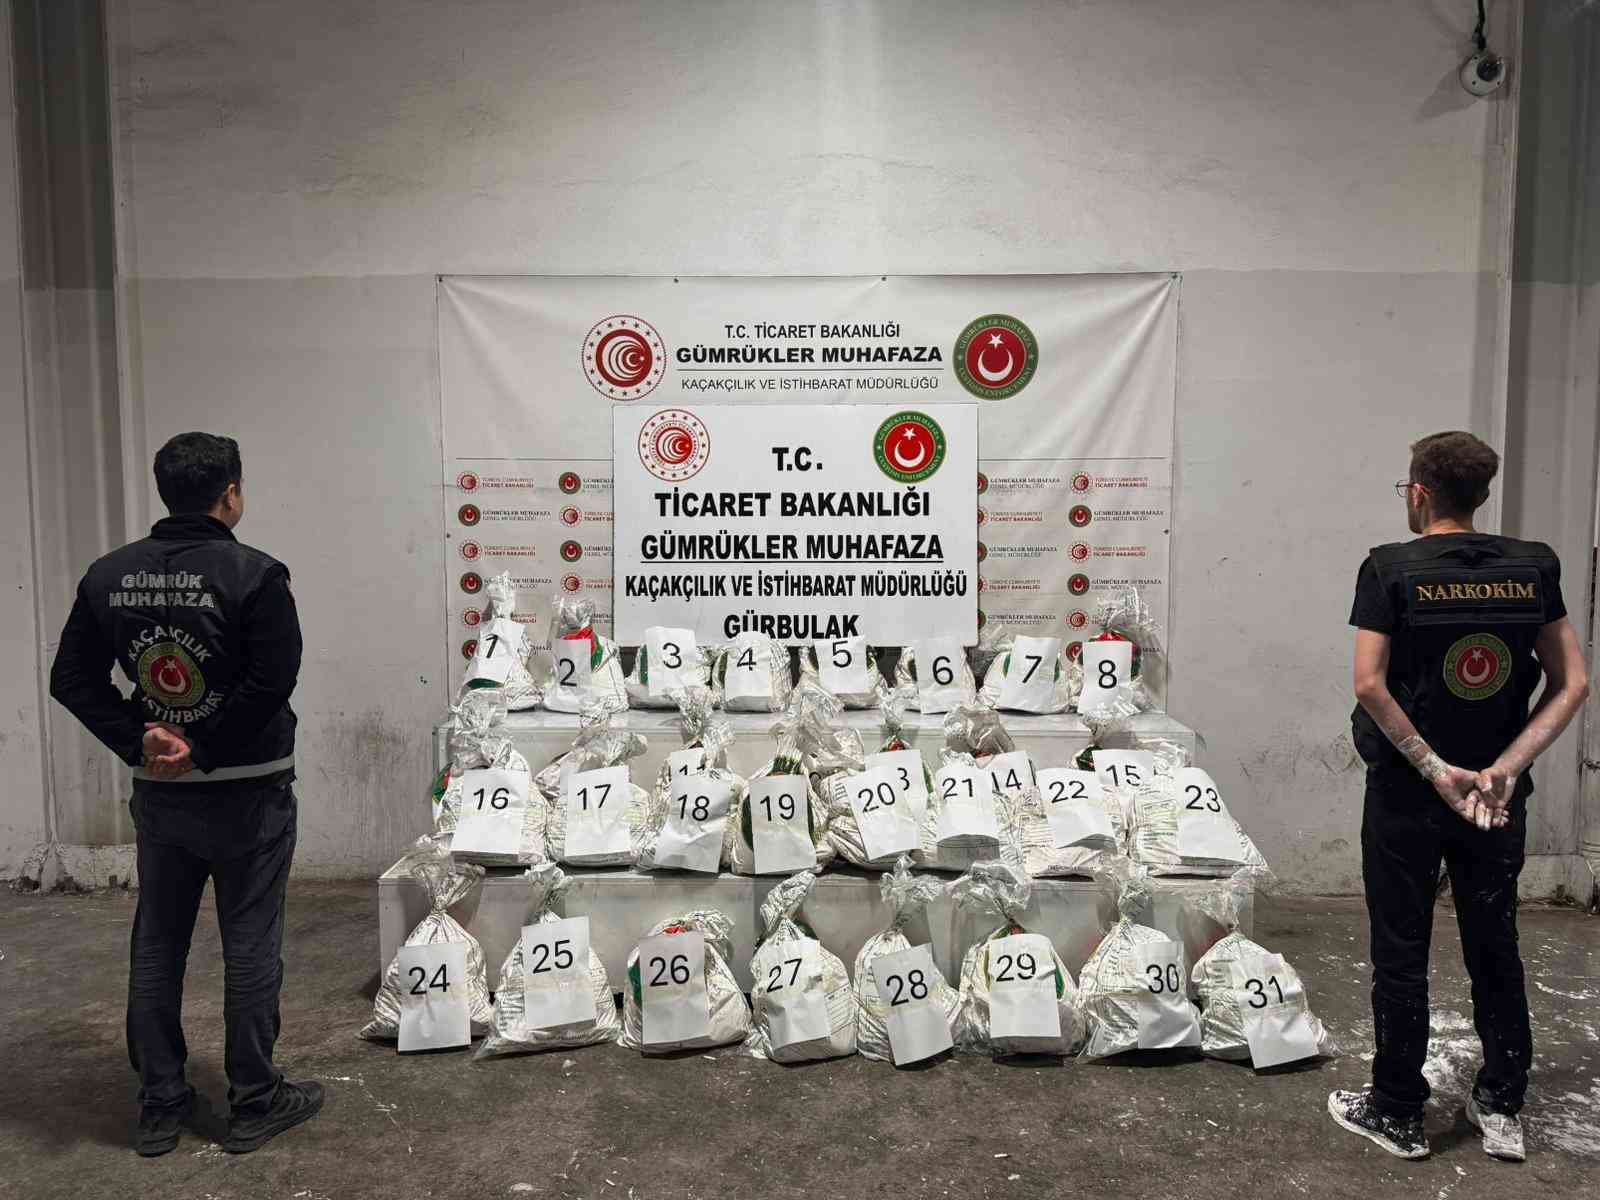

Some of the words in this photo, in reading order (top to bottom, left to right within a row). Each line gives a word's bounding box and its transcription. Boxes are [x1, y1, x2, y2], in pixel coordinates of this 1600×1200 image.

[725, 325, 749, 338] T.C.
[755, 325, 816, 338] TİCARET
[821, 322, 899, 338] BAKANLIĞI
[677, 345, 814, 362] GÜMRÜKLER
[823, 347, 942, 362] MUHAFAZA
[682, 379, 755, 392] KAÇAKÇILIK
[760, 380, 775, 389] VE
[781, 379, 851, 389] İSTİHBARAT
[857, 377, 938, 389] MÜDÜRLÜĞÜ
[773, 447, 822, 471] T.C.
[655, 487, 771, 517] TİCARET
[781, 487, 929, 516] BAKANLIĞI
[642, 530, 798, 559] GÜMRÜKLER
[807, 535, 943, 559] MUHAFAZA
[121, 570, 205, 588] GÜMRÜK
[626, 576, 726, 602] KAÇAKÇILIK
[731, 576, 752, 596] VE
[759, 570, 855, 596] İSTİHBARAT
[862, 570, 966, 596] MÜDÜRLÜĞÜ
[1416, 579, 1537, 601] NARKOKİM
[109, 591, 215, 608] MUHAFAZA
[725, 610, 858, 639] GÜRBULAK
[486, 635, 498, 658] 1
[664, 643, 681, 668] 3
[737, 649, 756, 670] 4
[833, 641, 851, 667] 5
[560, 659, 576, 686] 2
[933, 656, 953, 685] 6
[1023, 656, 1041, 683] 7
[1099, 660, 1117, 688] 8
[943, 778, 972, 799] 21
[992, 769, 1021, 791] 14
[1106, 765, 1140, 786] 15
[474, 788, 509, 809] 16
[578, 784, 610, 810] 17
[859, 783, 895, 812] 20
[1050, 781, 1088, 803] 22
[1186, 785, 1220, 812] 23
[678, 795, 709, 821] 18
[760, 794, 794, 821] 19
[533, 940, 572, 973] 25
[997, 954, 1035, 981] 29
[409, 964, 449, 995] 24
[650, 955, 689, 986] 26
[767, 959, 801, 992] 27
[1147, 964, 1179, 993] 30
[887, 970, 927, 1006] 28
[1246, 976, 1283, 1008] 31
